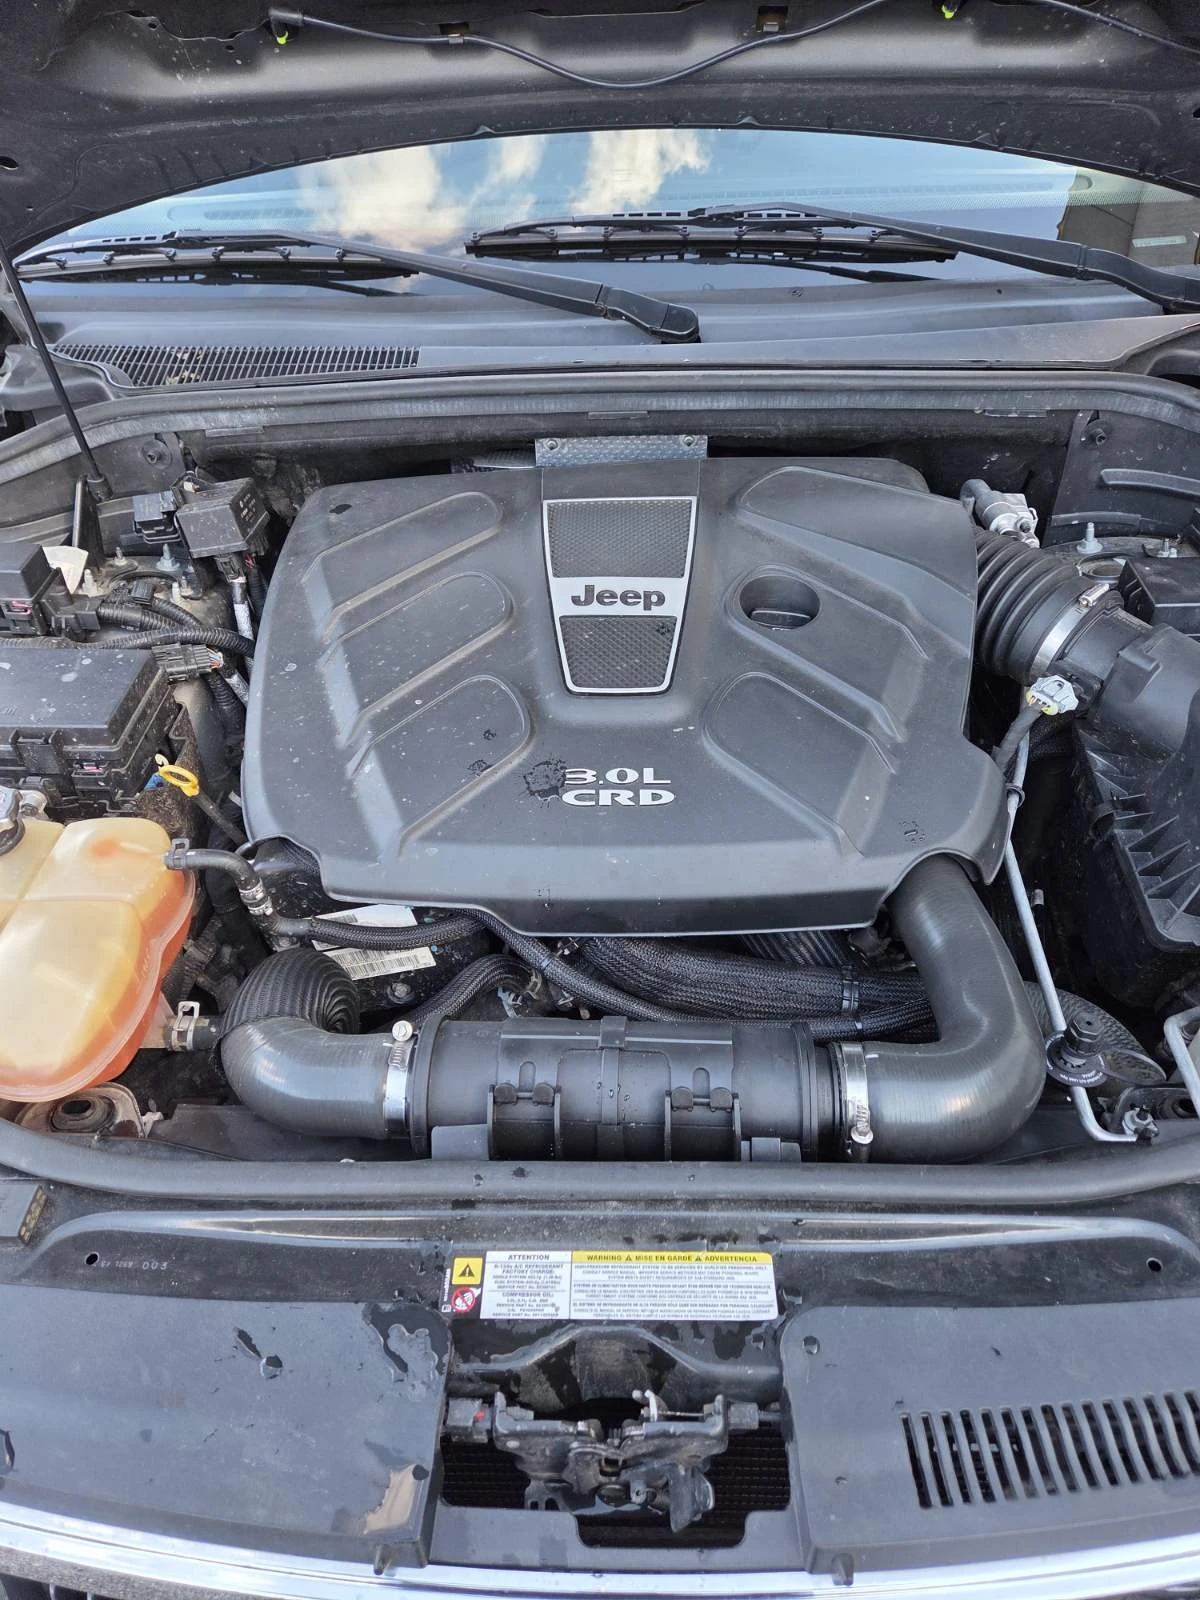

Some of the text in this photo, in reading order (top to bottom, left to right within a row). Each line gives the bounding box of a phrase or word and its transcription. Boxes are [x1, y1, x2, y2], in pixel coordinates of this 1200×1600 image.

[571, 584, 666, 611] Jeep
[564, 767, 671, 785] 3.0L
[562, 789, 675, 807] CRD
[587, 1254, 622, 1262] WARNING
[635, 1254, 653, 1262] MISE
[655, 1254, 665, 1262] EN
[667, 1254, 693, 1262] GARDE
